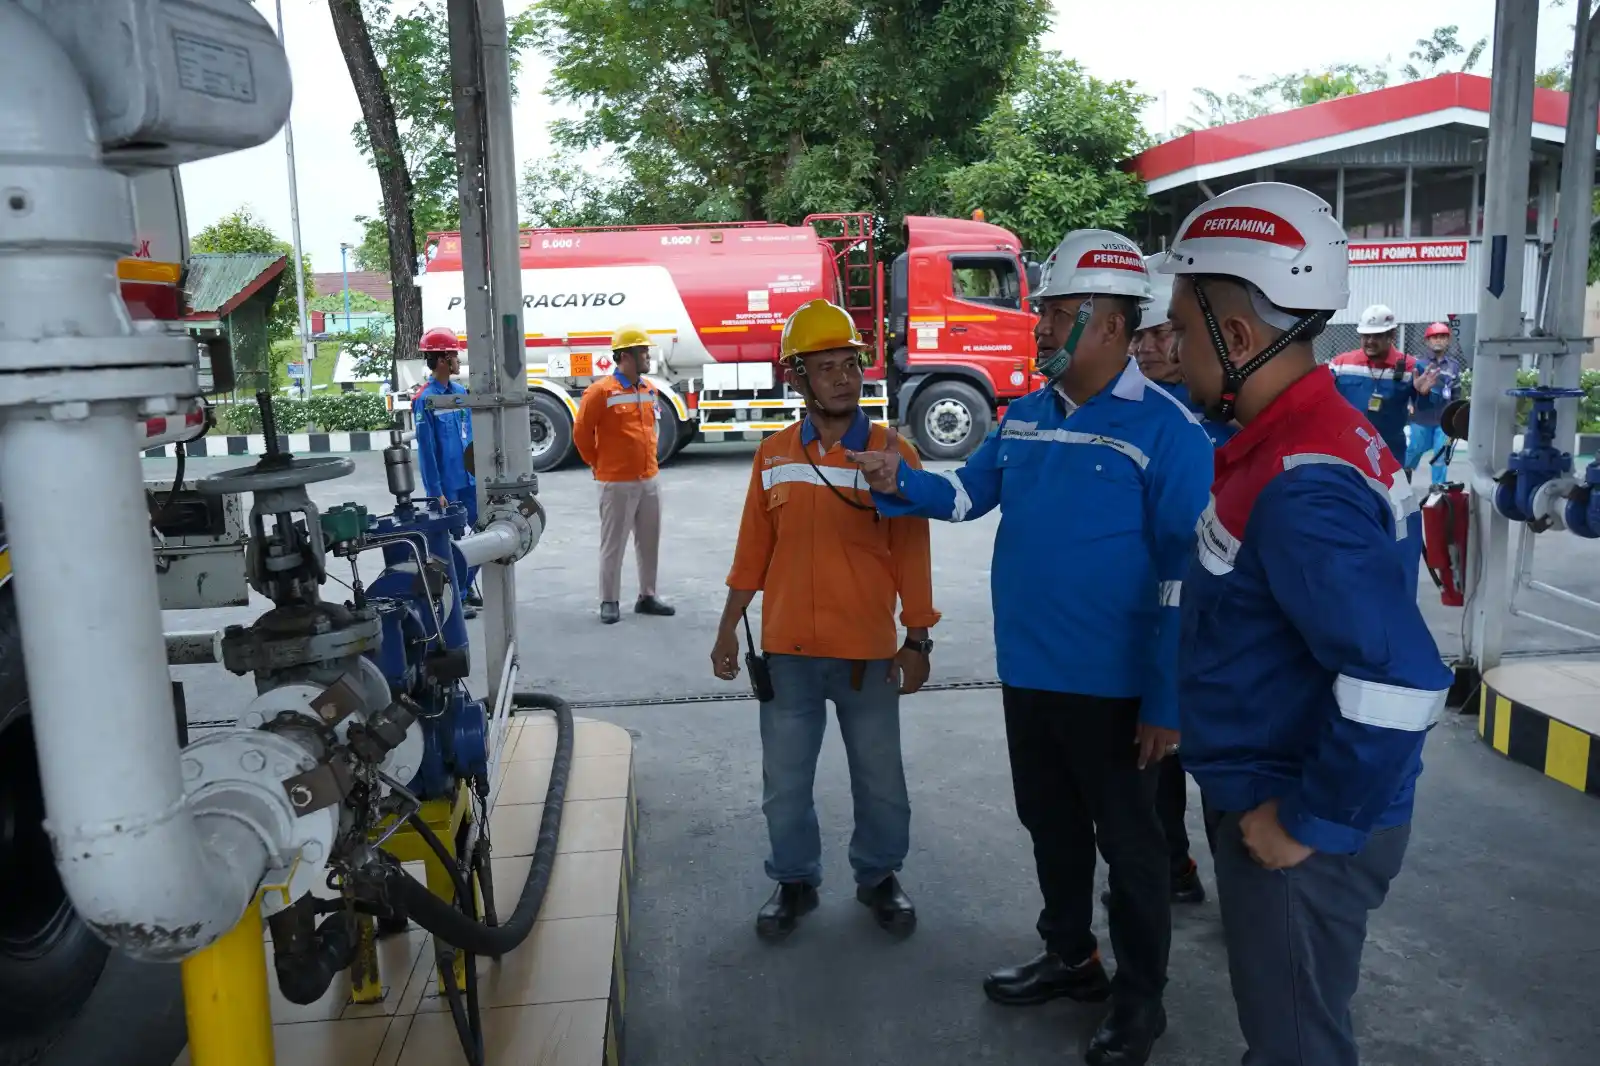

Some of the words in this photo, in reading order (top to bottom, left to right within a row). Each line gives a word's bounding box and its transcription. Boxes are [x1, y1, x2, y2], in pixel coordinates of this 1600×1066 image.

[1203, 218, 1276, 236] PERTAMINA
[1348, 248, 1380, 261] UMAH
[1382, 246, 1418, 260] POMPA
[1420, 245, 1464, 258] PRODUK
[522, 291, 627, 309] RACAYBO
